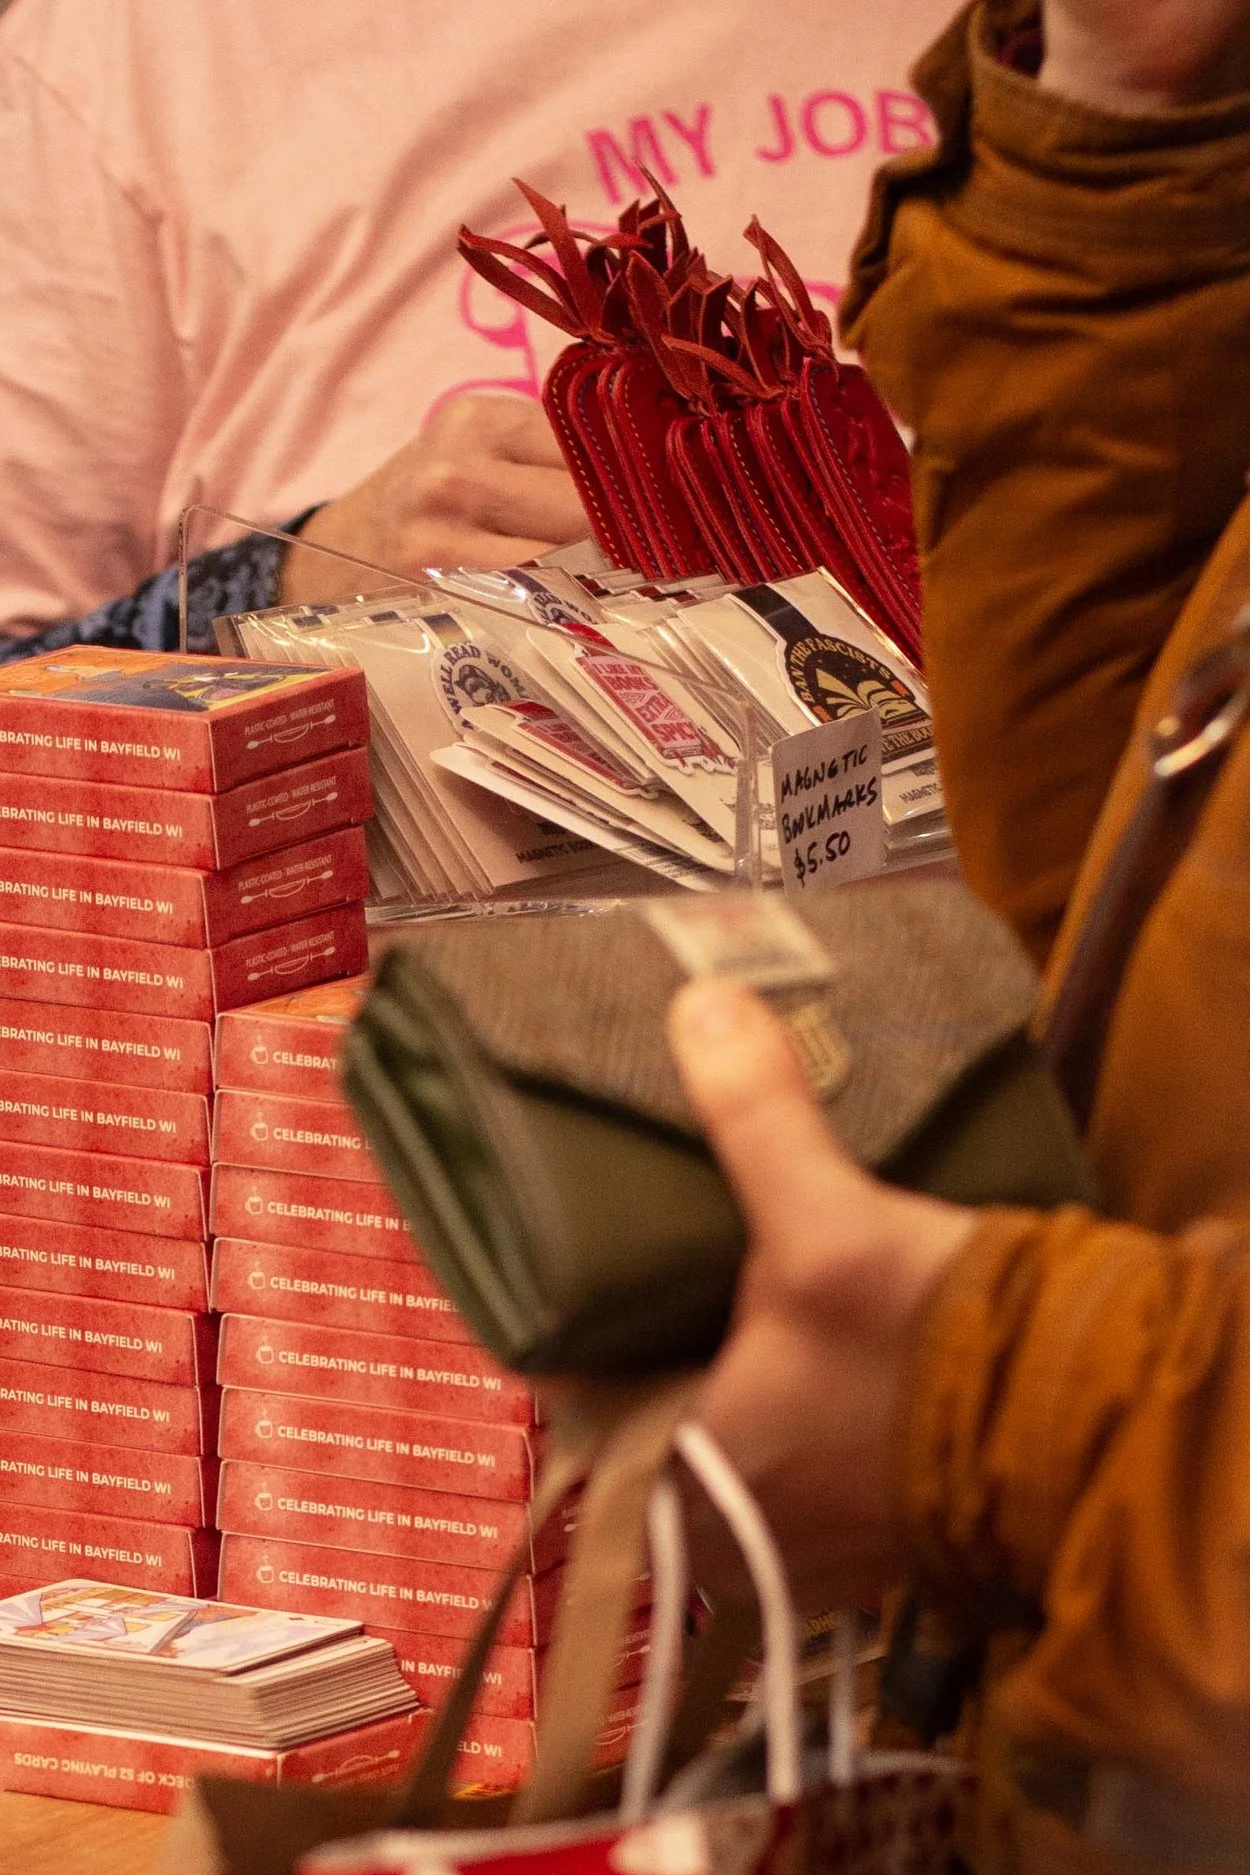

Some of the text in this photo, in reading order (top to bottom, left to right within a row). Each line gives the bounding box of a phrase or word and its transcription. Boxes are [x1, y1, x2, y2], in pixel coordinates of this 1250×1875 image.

[587, 88, 941, 203] MY JOB
[443, 644, 482, 666] READ
[790, 637, 891, 703] BAN THE FASCISTS
[55, 735, 81, 751] LIFE
[84, 738, 97, 753] IN
[100, 740, 160, 759] BAYFIELD
[163, 746, 180, 761] WI
[781, 744, 868, 804] MAGNETIC
[58, 812, 83, 827] LIFE
[86, 815, 99, 829] IN
[103, 817, 162, 835] BAYFIELD
[165, 823, 182, 837] WI
[781, 776, 879, 844] BOOKMARKS
[793, 830, 851, 888] $5.50
[58, 963, 83, 978] LIFE
[87, 966, 99, 980] IN
[103, 968, 163, 987] BAYFIELD
[165, 976, 183, 989] WI
[57, 1033, 82, 1049] LIFE
[85, 1037, 98, 1051] IN
[101, 1039, 160, 1059] BAYFIELD
[163, 1046, 180, 1061] WI
[272, 1050, 337, 1070] CELEBRAT
[272, 1126, 360, 1149] CELEBRATING
[49, 1180, 74, 1196] LIFE
[76, 1184, 89, 1198] IN
[92, 1186, 151, 1206] BAYFIELD
[153, 1194, 170, 1208] WI
[266, 1201, 352, 1224] CELEBRATING
[356, 1213, 381, 1228] LIFE
[385, 1217, 398, 1230] IN
[50, 1252, 76, 1268] LIFE
[79, 1256, 91, 1270] IN
[95, 1258, 154, 1278] BAYFIELD
[157, 1266, 175, 1281] WI
[269, 1276, 451, 1311] CELEBRATING LIFE IN BAYFIE
[278, 1350, 501, 1390] CELEBRATING LIFE IN BAYFIELD WI
[47, 1394, 72, 1410] LIFE
[75, 1398, 87, 1412] IN
[91, 1400, 150, 1420] BAYFIELD
[152, 1408, 169, 1423] WI
[277, 1498, 497, 1539] CELEBRATING LIFE IN BAYFIELD WI
[41, 1538, 66, 1554] LIFE
[69, 1542, 81, 1556] IN
[84, 1544, 142, 1565] BAYFIELD
[144, 1553, 162, 1567] WI
[278, 1571, 367, 1595] CELEBRATING
[369, 1583, 396, 1599] LIFE
[399, 1586, 413, 1601] IN
[416, 1589, 478, 1610] BAYFIELD
[401, 1659, 414, 1672] IN
[484, 1744, 502, 1757] WI
[14, 1753, 195, 1789] DECK OF 52 PLAYING CARDS
